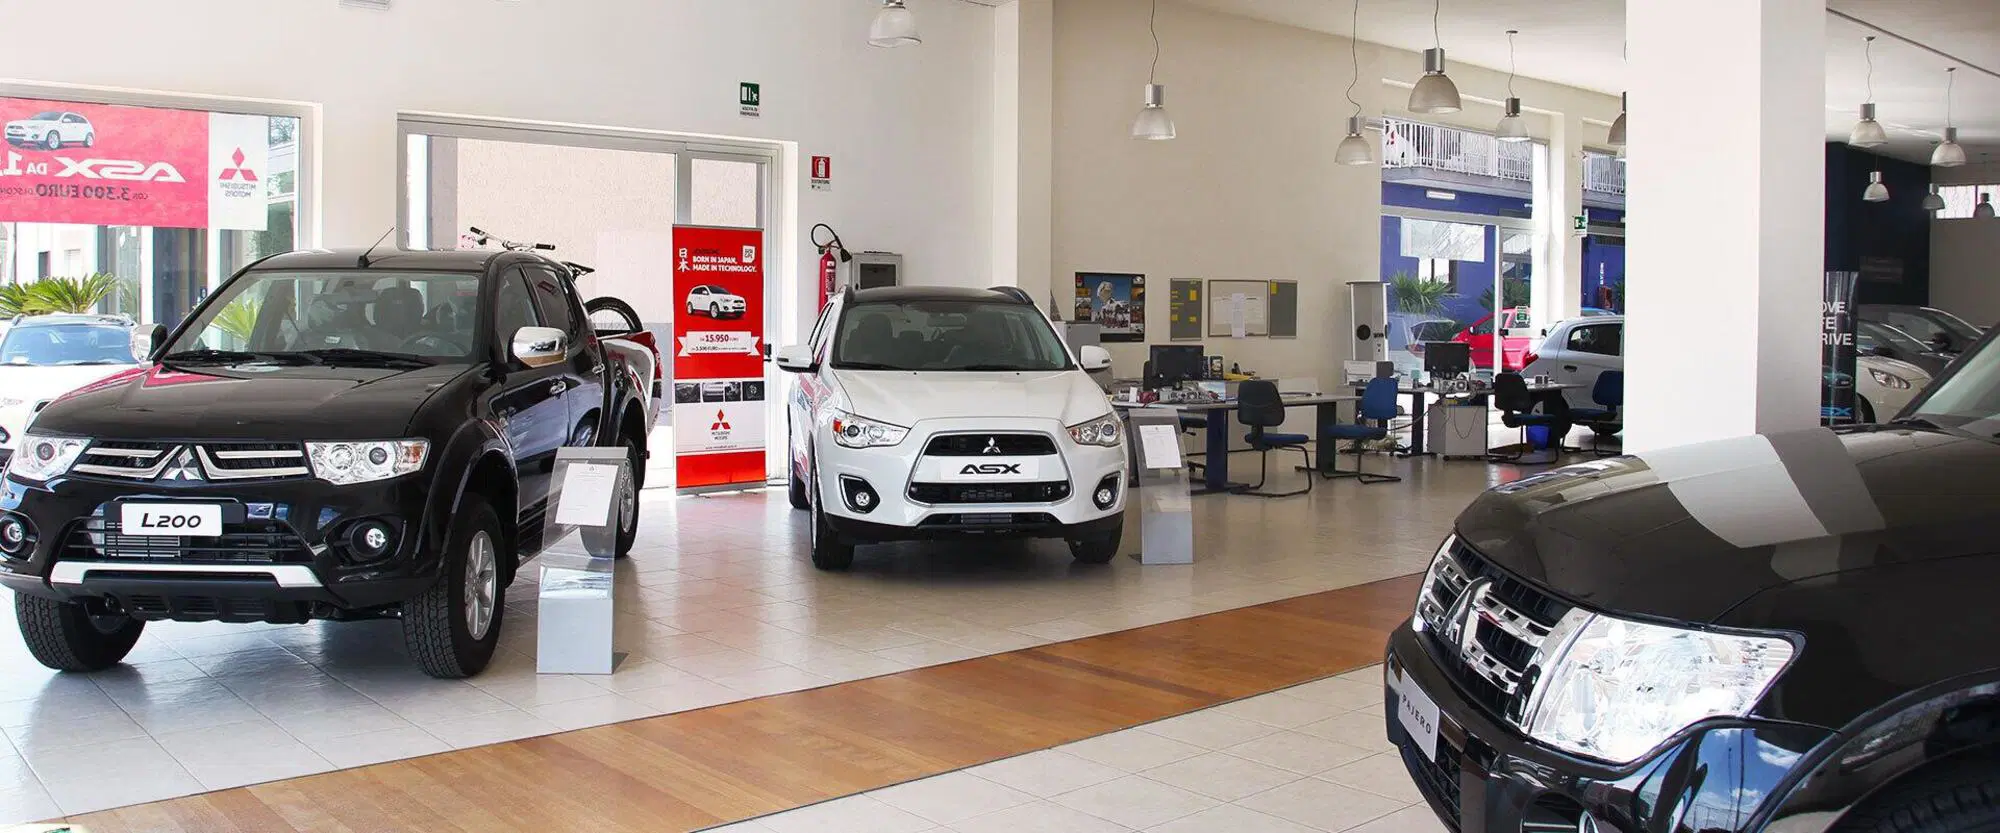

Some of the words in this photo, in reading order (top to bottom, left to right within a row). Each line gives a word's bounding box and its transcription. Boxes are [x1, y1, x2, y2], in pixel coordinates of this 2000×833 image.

[678, 247, 690, 272] 日本
[705, 334, 730, 343] 15.950
[959, 463, 1021, 475] ASX
[141, 512, 202, 528] L200
[1402, 693, 1432, 735] PAJERO
